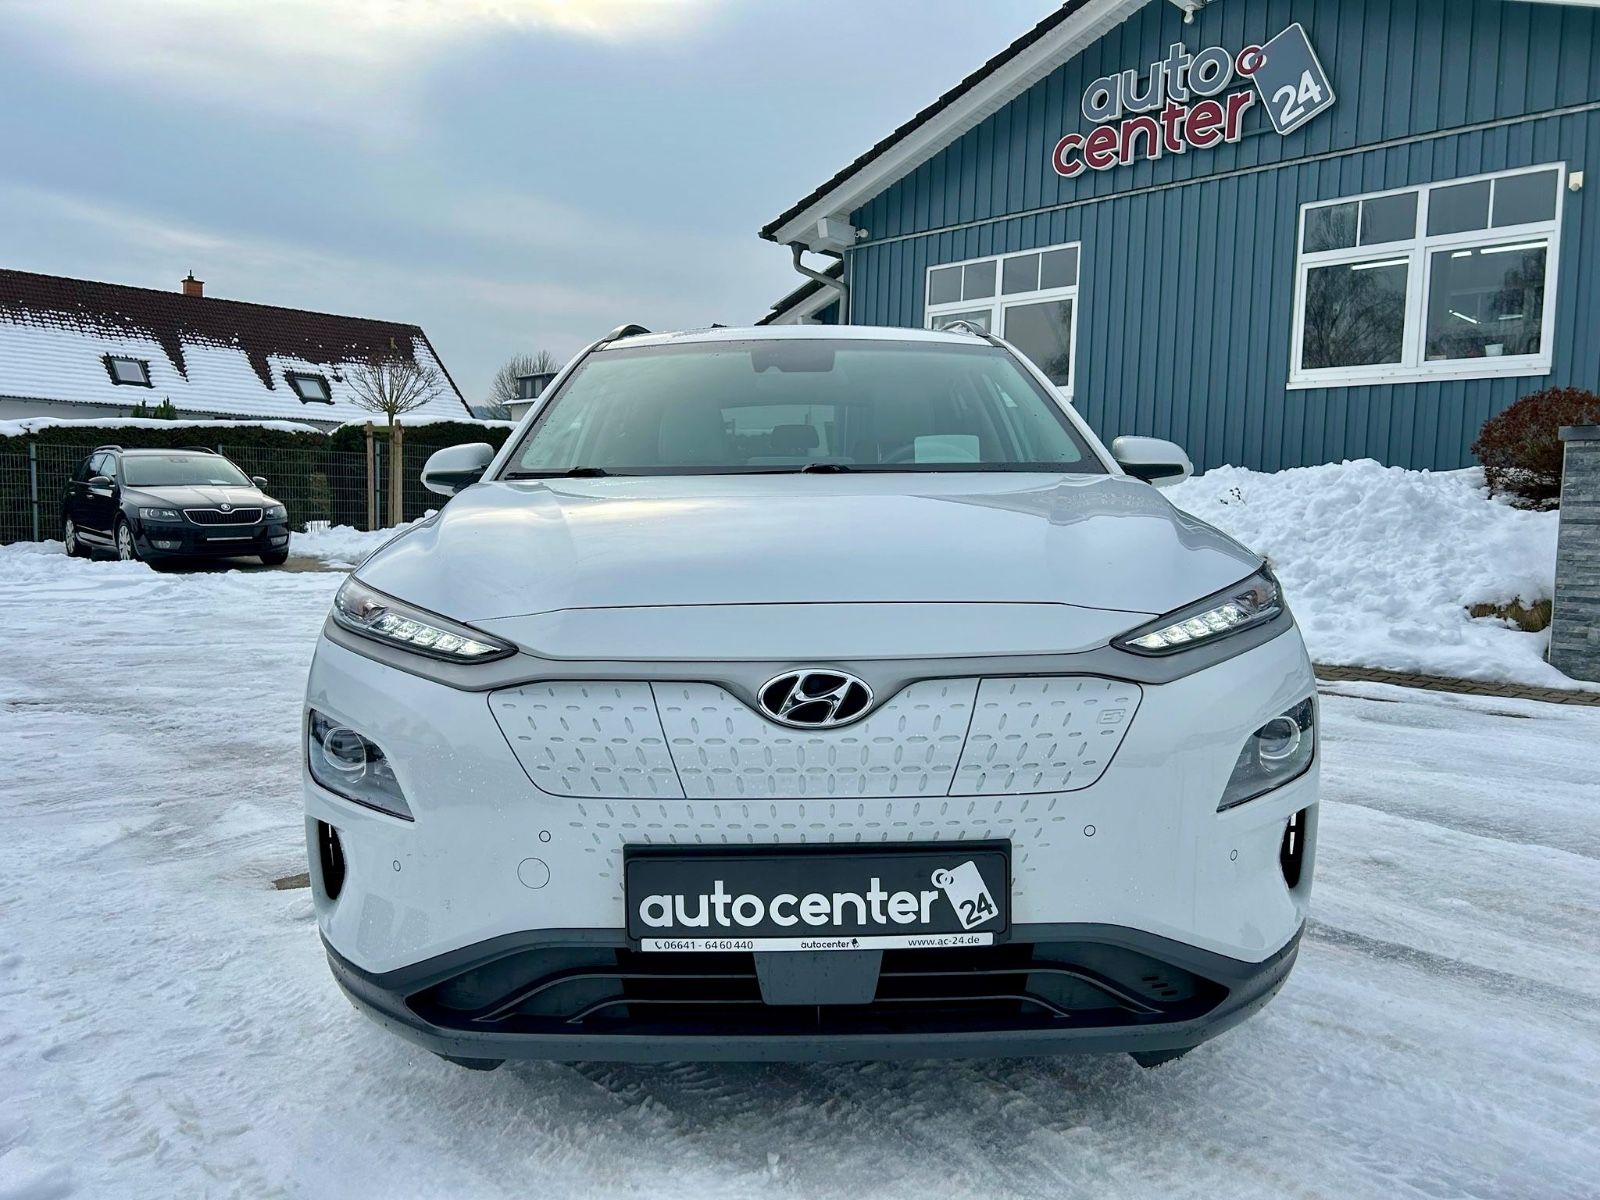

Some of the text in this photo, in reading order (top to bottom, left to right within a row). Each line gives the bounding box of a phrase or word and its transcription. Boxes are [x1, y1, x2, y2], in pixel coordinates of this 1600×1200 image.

[1082, 42, 1234, 123] auto
[1272, 70, 1321, 125] 24
[1052, 90, 1255, 178] center
[958, 893, 993, 924] 24
[663, 940, 696, 950] 06641
[800, 940, 850, 949] autocenter
[908, 936, 980, 947] www.ac-24.de
